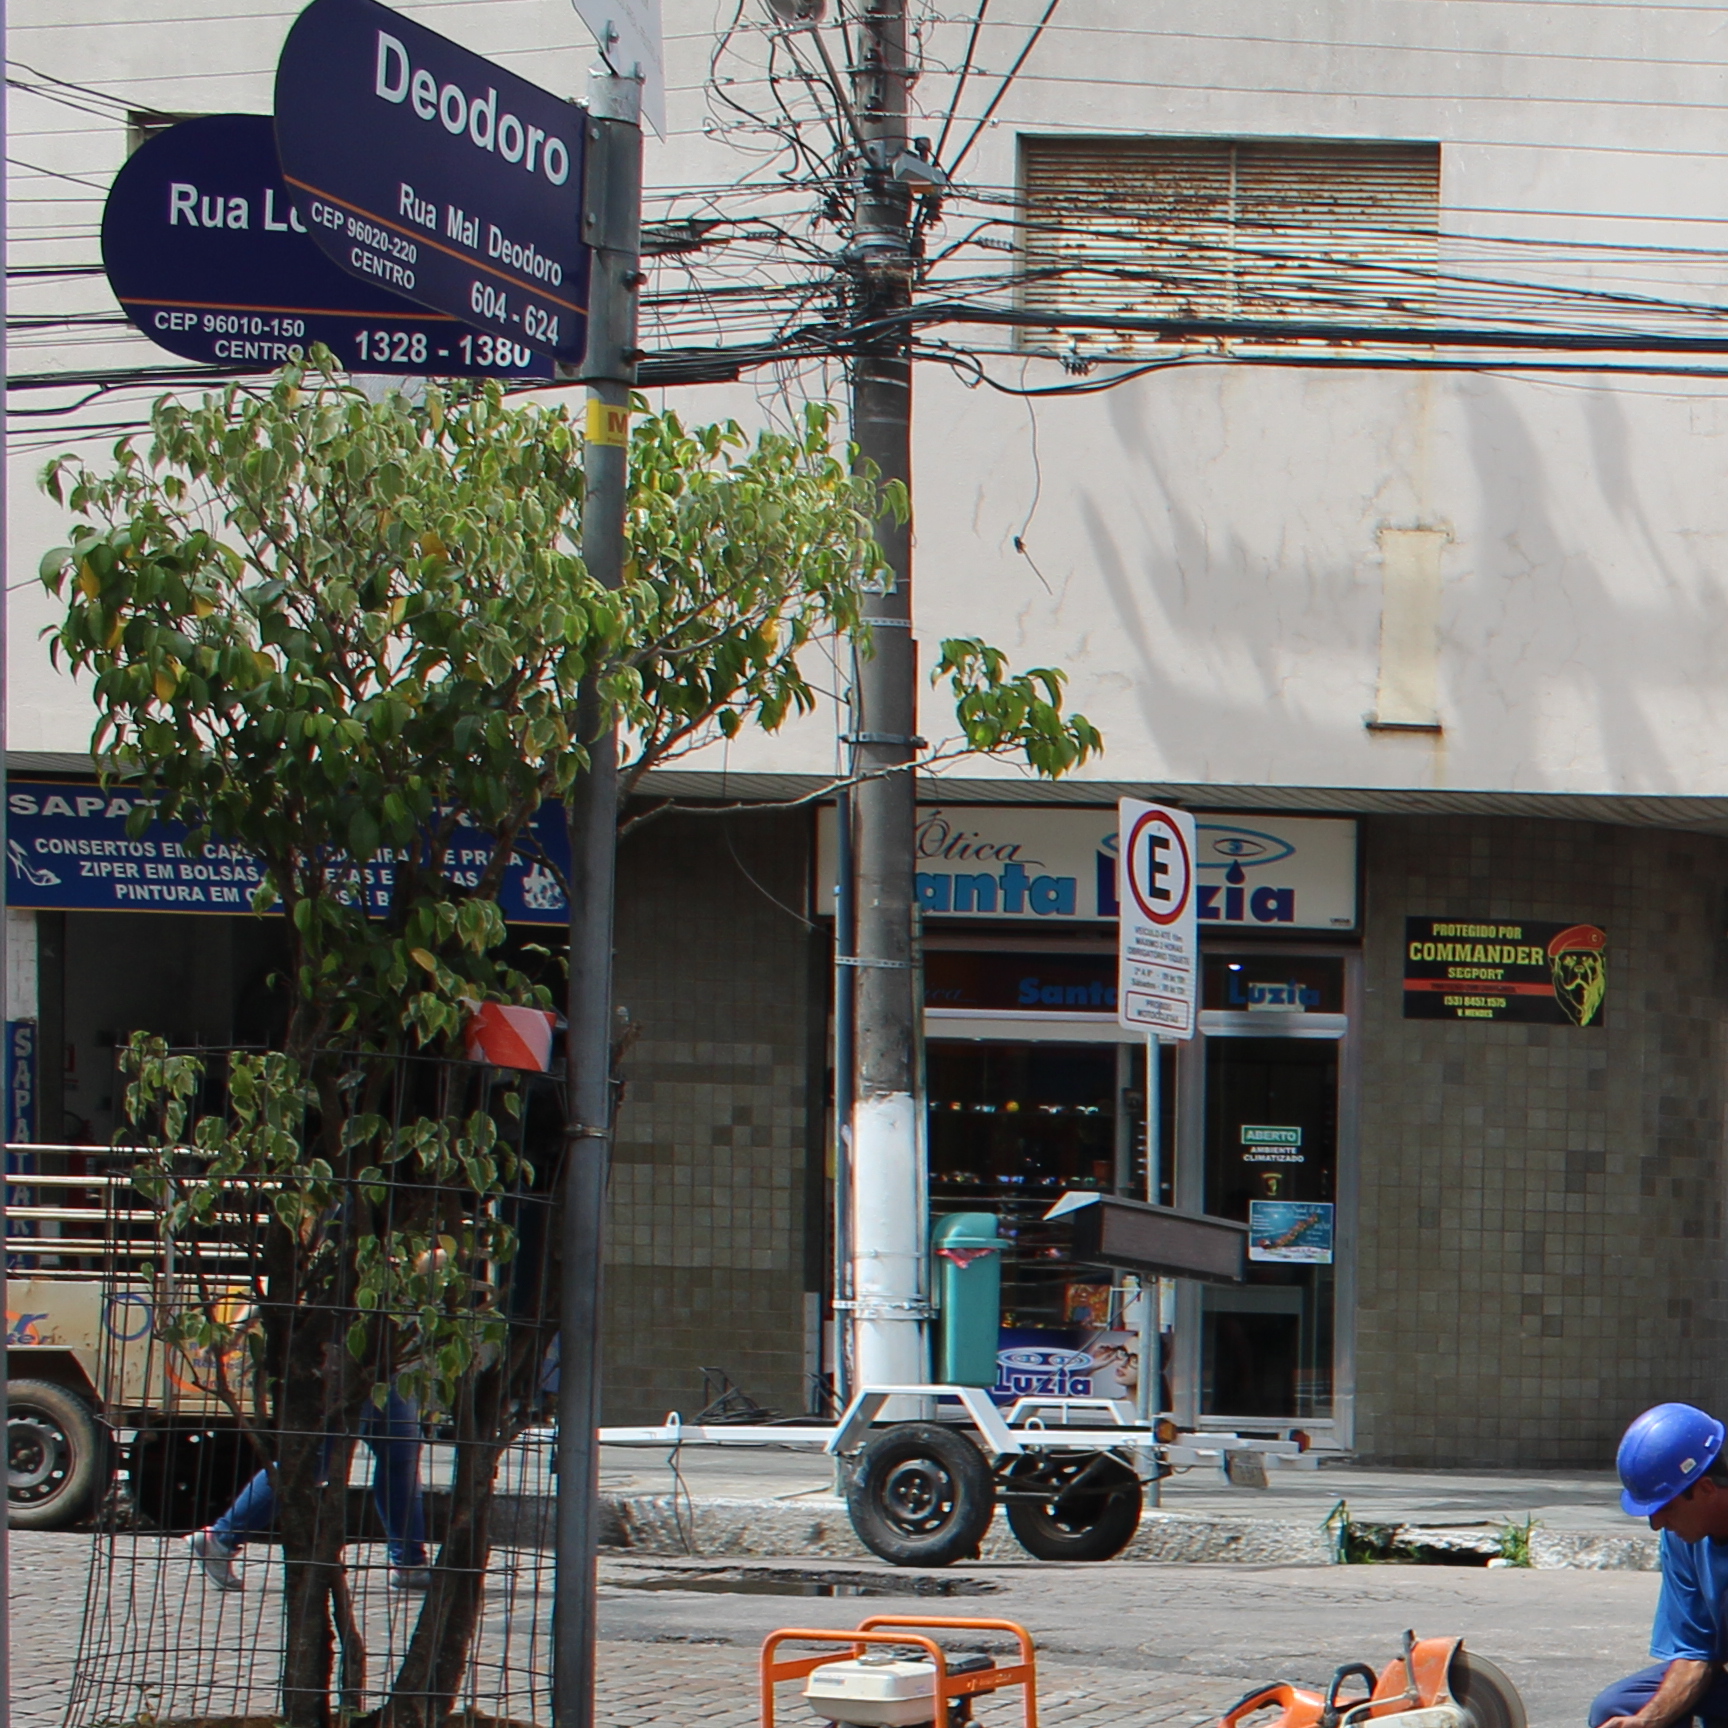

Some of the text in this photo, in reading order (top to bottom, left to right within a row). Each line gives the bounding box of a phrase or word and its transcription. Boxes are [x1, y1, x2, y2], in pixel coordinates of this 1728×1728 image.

[376, 29, 570, 186] Deodoro
[169, 182, 249, 230] Rua
[311, 201, 418, 264] CEP 96020-220
[400, 182, 563, 287] Rua Mal Deodoro
[351, 246, 416, 290] CENTRO
[154, 311, 305, 338] CEP 96010-150
[471, 281, 507, 323] 604
[524, 304, 559, 347] 624
[214, 339, 305, 361] CENTRO
[354, 329, 428, 364] 1328
[458, 334, 532, 368] 1380
[35, 838, 157, 859] CONSERTOS
[460, 850, 524, 867] PRA
[913, 807, 1046, 868] Ótica
[79, 861, 141, 879] ZIPER
[145, 864, 176, 880] EM
[1148, 833, 1172, 903] E
[115, 884, 203, 902] PINTURA
[210, 886, 239, 903] EM
[914, 847, 1295, 924] anta Lzia
[1432, 922, 1522, 940] PROTEGIDO POR
[1409, 941, 1545, 966] COMMANDER
[1447, 966, 1505, 980] SEGPORT
[1245, 1129, 1297, 1141] ABERTO
[1243, 1154, 1305, 1163] CLIMATIZADO
